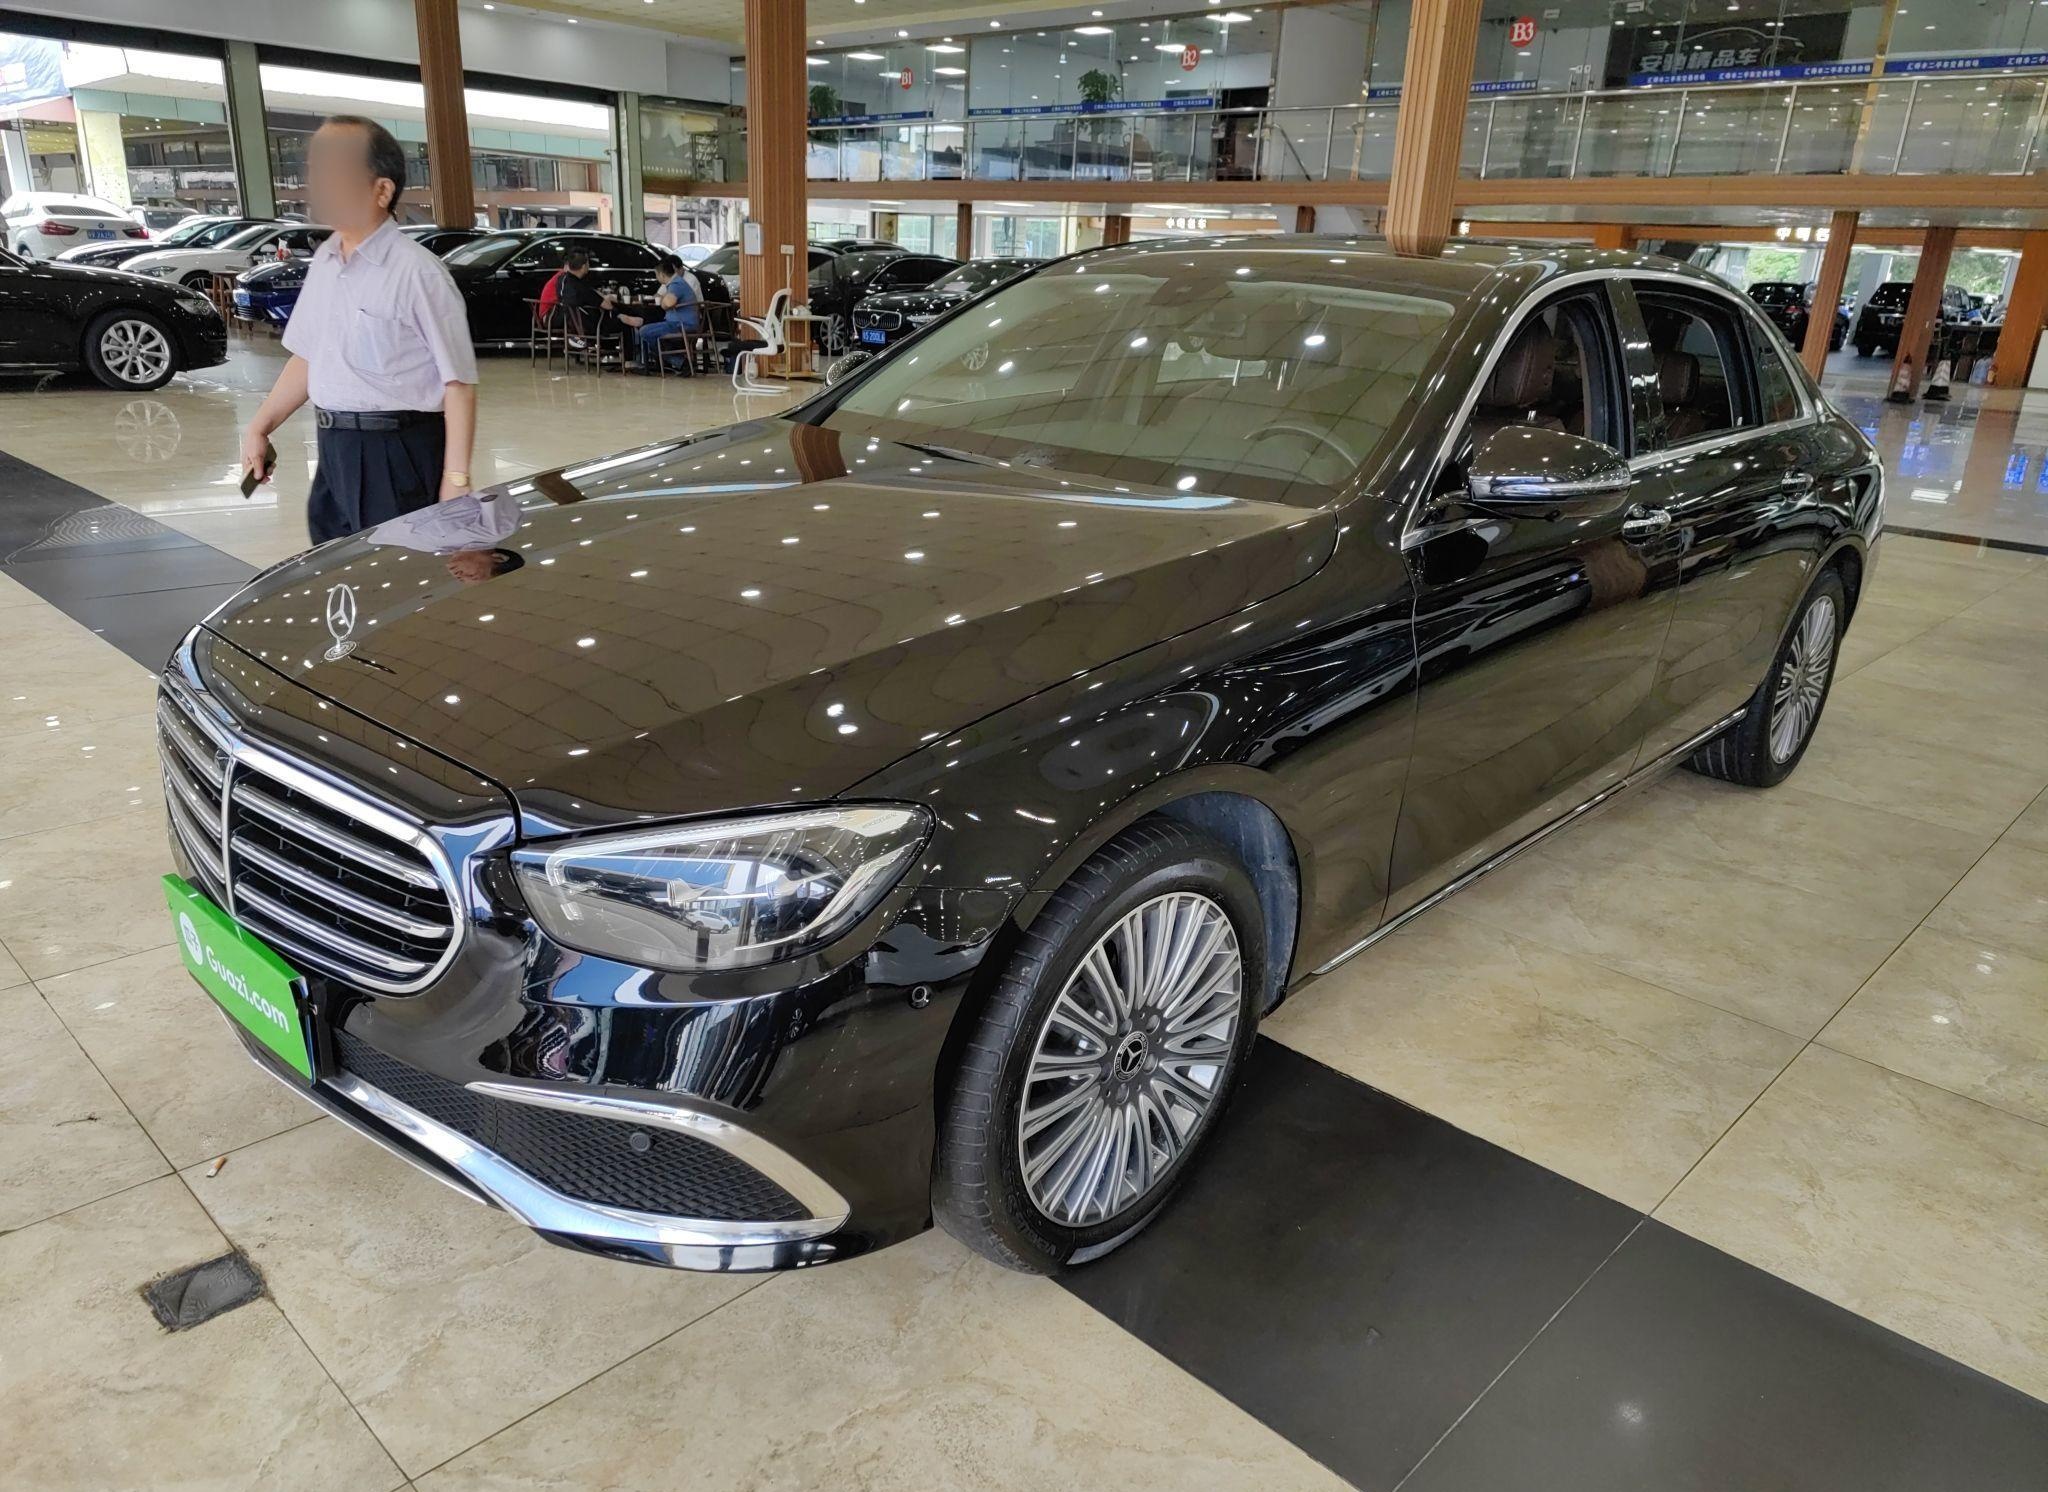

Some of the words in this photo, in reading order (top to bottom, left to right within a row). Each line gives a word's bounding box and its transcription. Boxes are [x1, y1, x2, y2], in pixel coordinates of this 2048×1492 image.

[1511, 22, 1534, 42] B3
[1181, 50, 1197, 66] B2
[901, 71, 912, 85] B1
[205, 944, 290, 1034] Guazi.com
